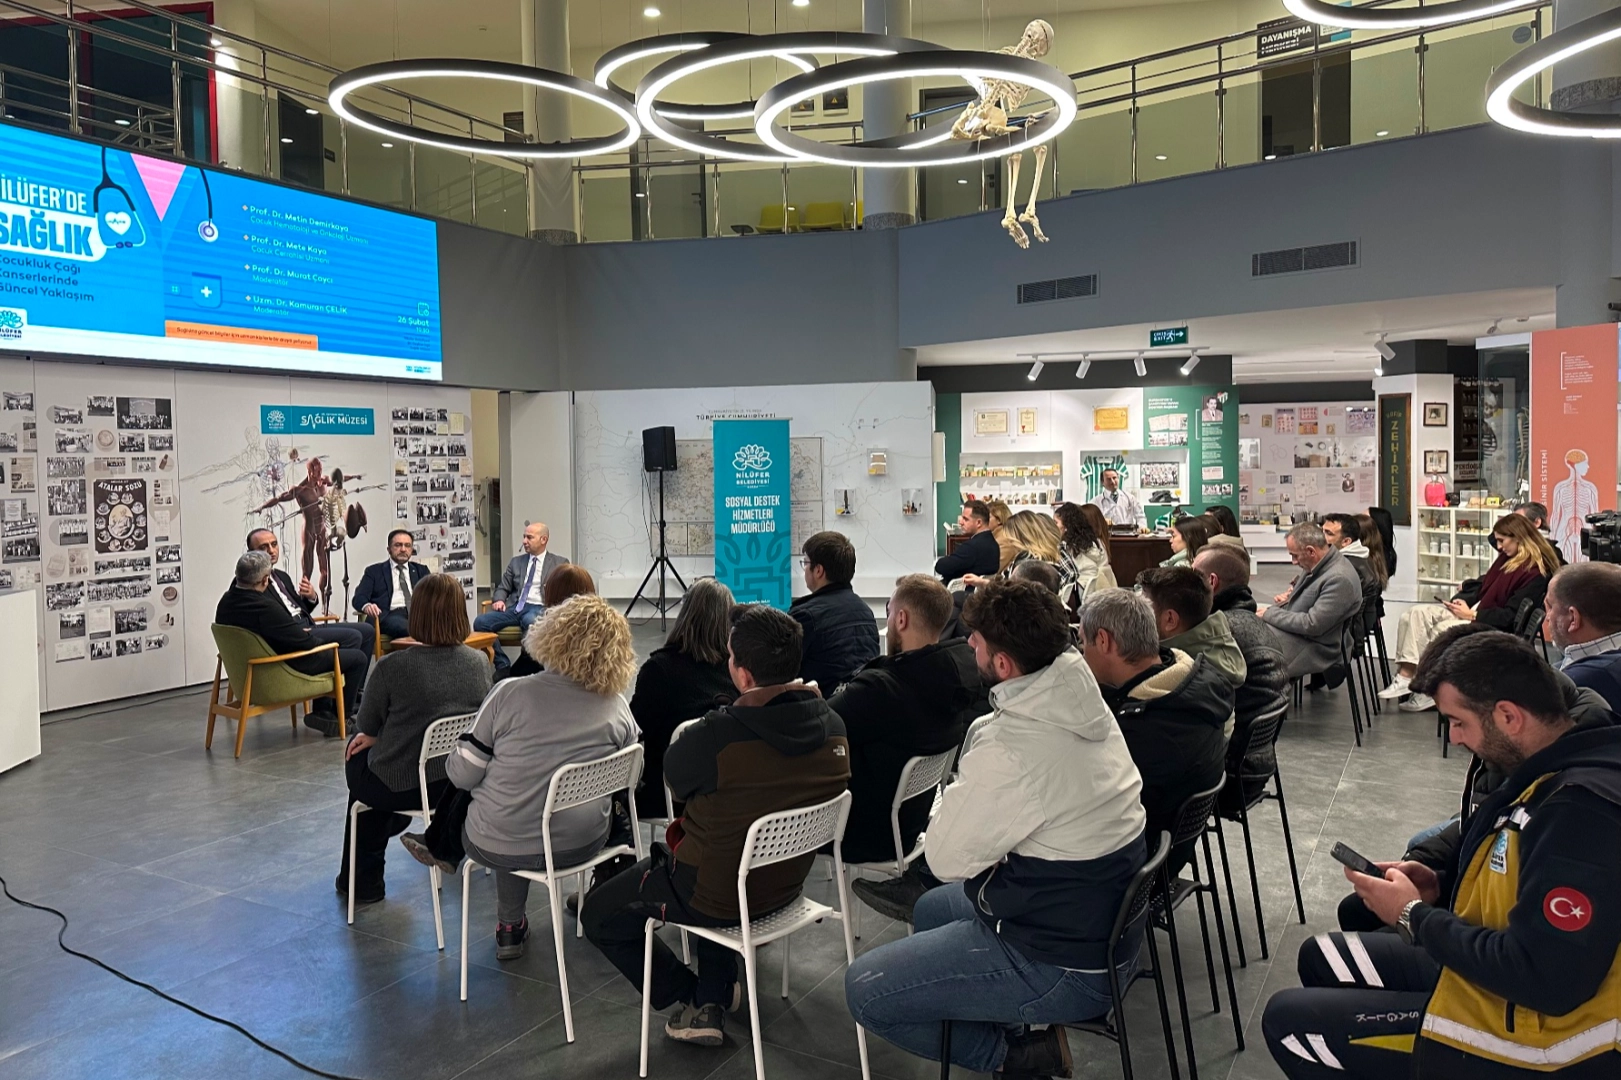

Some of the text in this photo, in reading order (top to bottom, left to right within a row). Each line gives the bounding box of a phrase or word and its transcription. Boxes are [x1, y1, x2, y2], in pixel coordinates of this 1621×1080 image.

[1261, 26, 1312, 44] DAYANIŞMA
[250, 205, 349, 232] Prof. Dr. Metin Demirkaya
[251, 235, 327, 255] Prof. Dr. Mete Kaya
[0, 254, 81, 275] ocukluk Çağı
[0, 268, 79, 286] anserlerinde
[252, 264, 333, 284] Prof. Dr. Murat Çaycı
[40, 287, 94, 302] Yaklaşım
[253, 295, 348, 315] Uzm. Dr. Kamuran ÇELİK
[408, 317, 430, 327] Şubat
[338, 414, 368, 425] MÜZESİ
[1391, 421, 1399, 506] ZEHİRLER
[1540, 449, 1548, 482] SİSTEMİ
[736, 470, 770, 479] NİLÜFER
[98, 481, 123, 492] ATALAR
[725, 494, 780, 508] SOSYAL DESTEK
[732, 507, 774, 521] HİZMETLERİ
[731, 519, 776, 534] MÜDÜRLÜĞÜ
